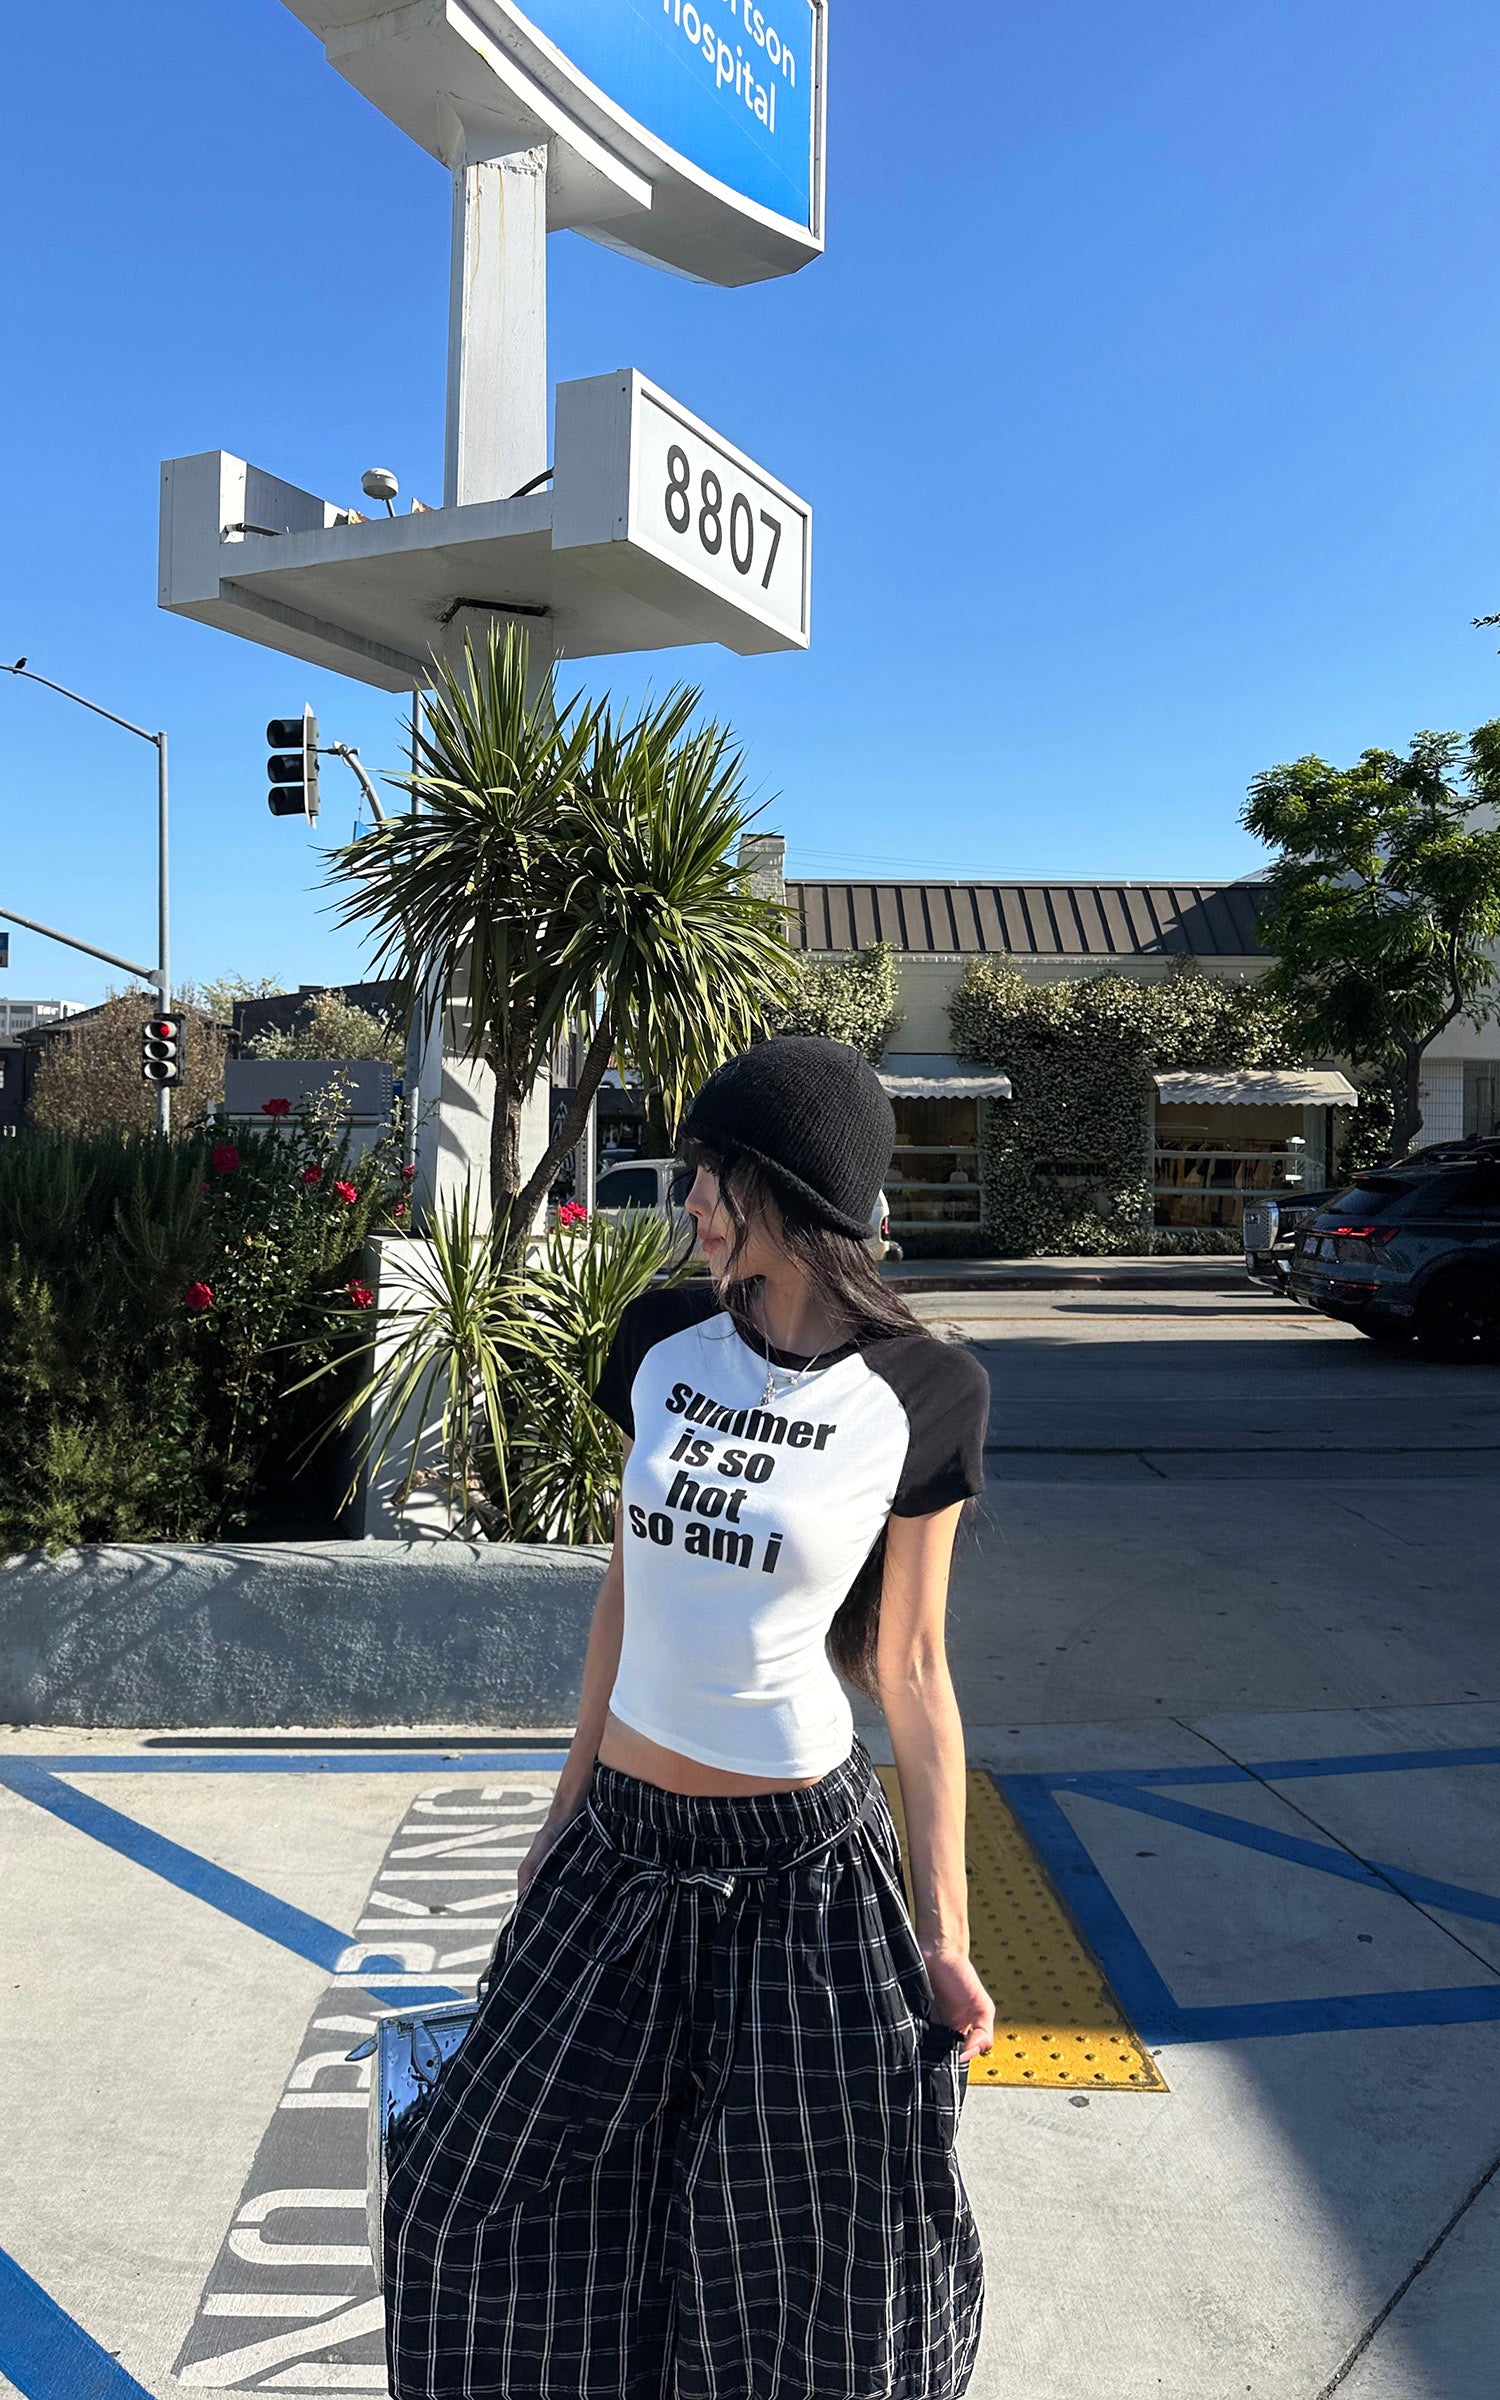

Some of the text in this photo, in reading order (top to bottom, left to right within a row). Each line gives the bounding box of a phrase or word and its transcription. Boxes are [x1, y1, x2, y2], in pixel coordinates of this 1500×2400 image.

[663, 0, 776, 134] ospital
[665, 445, 781, 589] 8807
[665, 1382, 837, 1451] summer
[669, 1428, 775, 1483] is so
[665, 1470, 747, 1524] hot
[629, 1504, 783, 1574] so am i
[178, 2187, 388, 2389] NO
